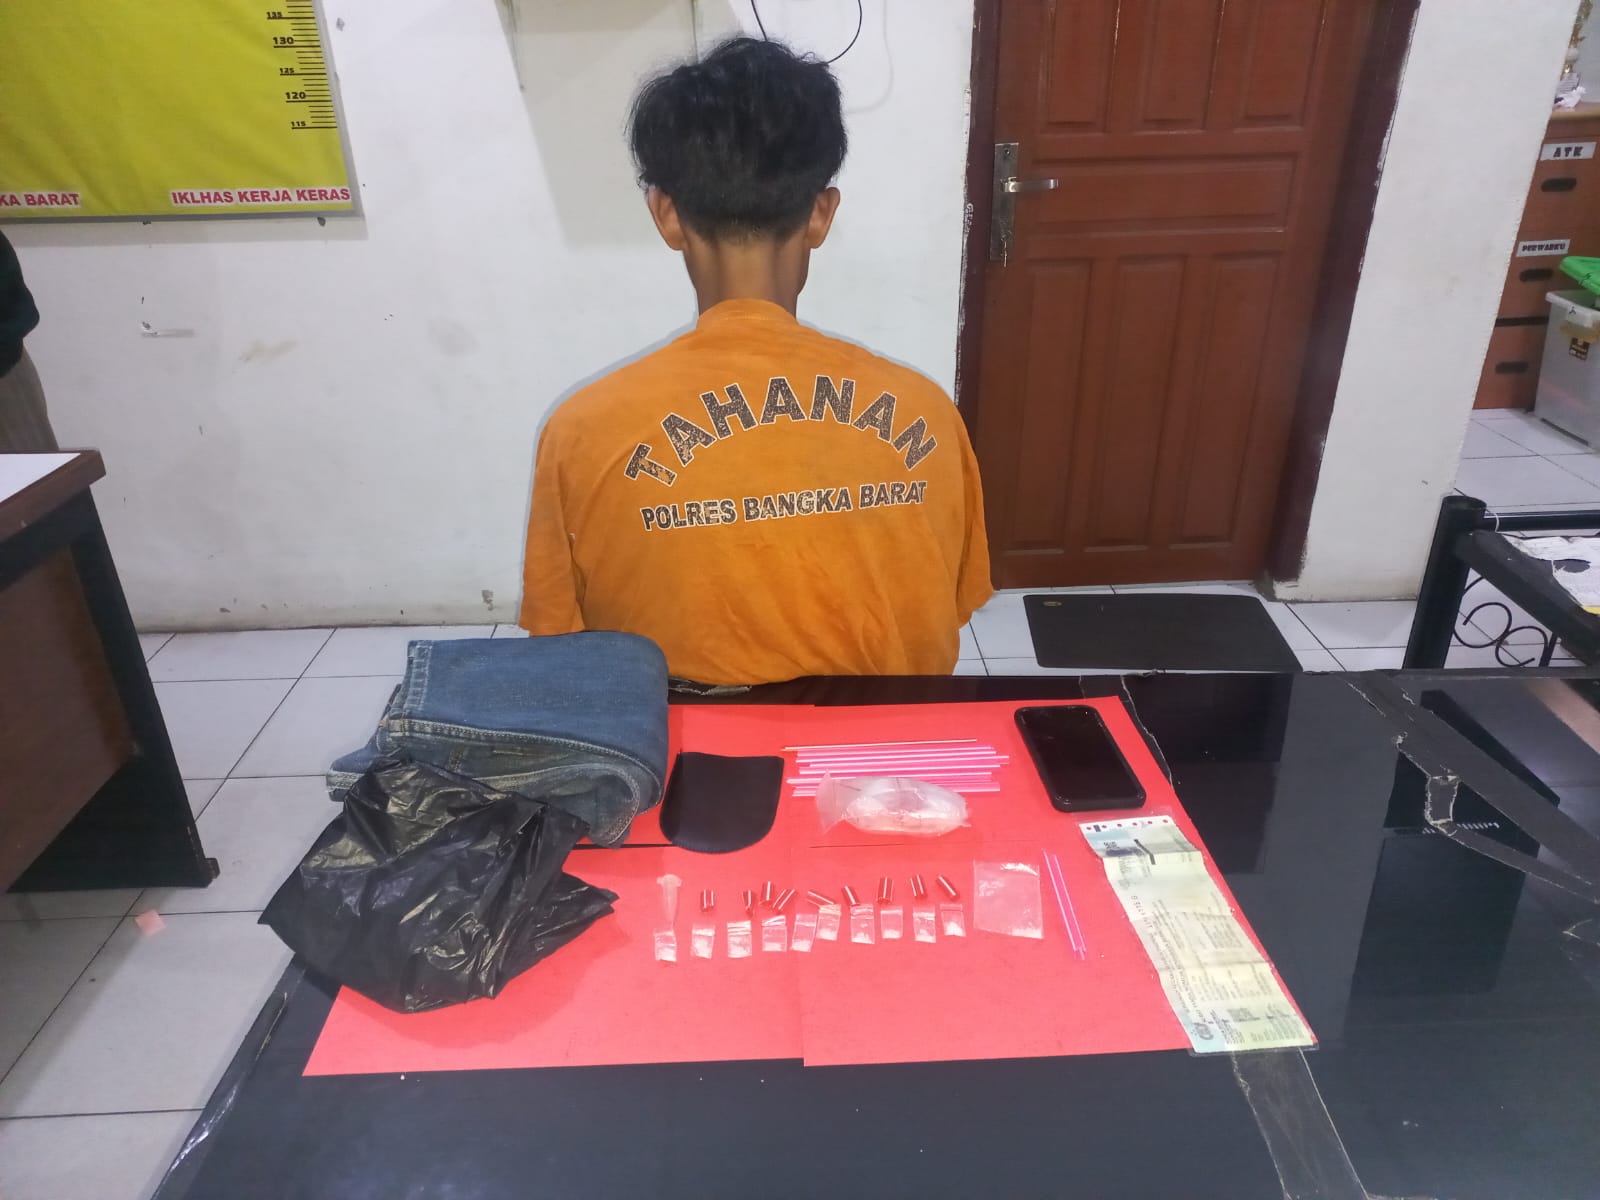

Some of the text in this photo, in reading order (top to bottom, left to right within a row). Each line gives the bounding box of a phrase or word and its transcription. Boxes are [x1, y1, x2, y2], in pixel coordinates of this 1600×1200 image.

[273, 36, 295, 45] 130
[285, 91, 306, 99] 120
[1553, 145, 1583, 158] ATK
[24, 192, 79, 206] BARAT
[171, 188, 350, 205] IKLHAS KERJA KERAS
[624, 374, 938, 488] TAHANAN
[640, 480, 928, 531] POLRES BANGKA BARAT
